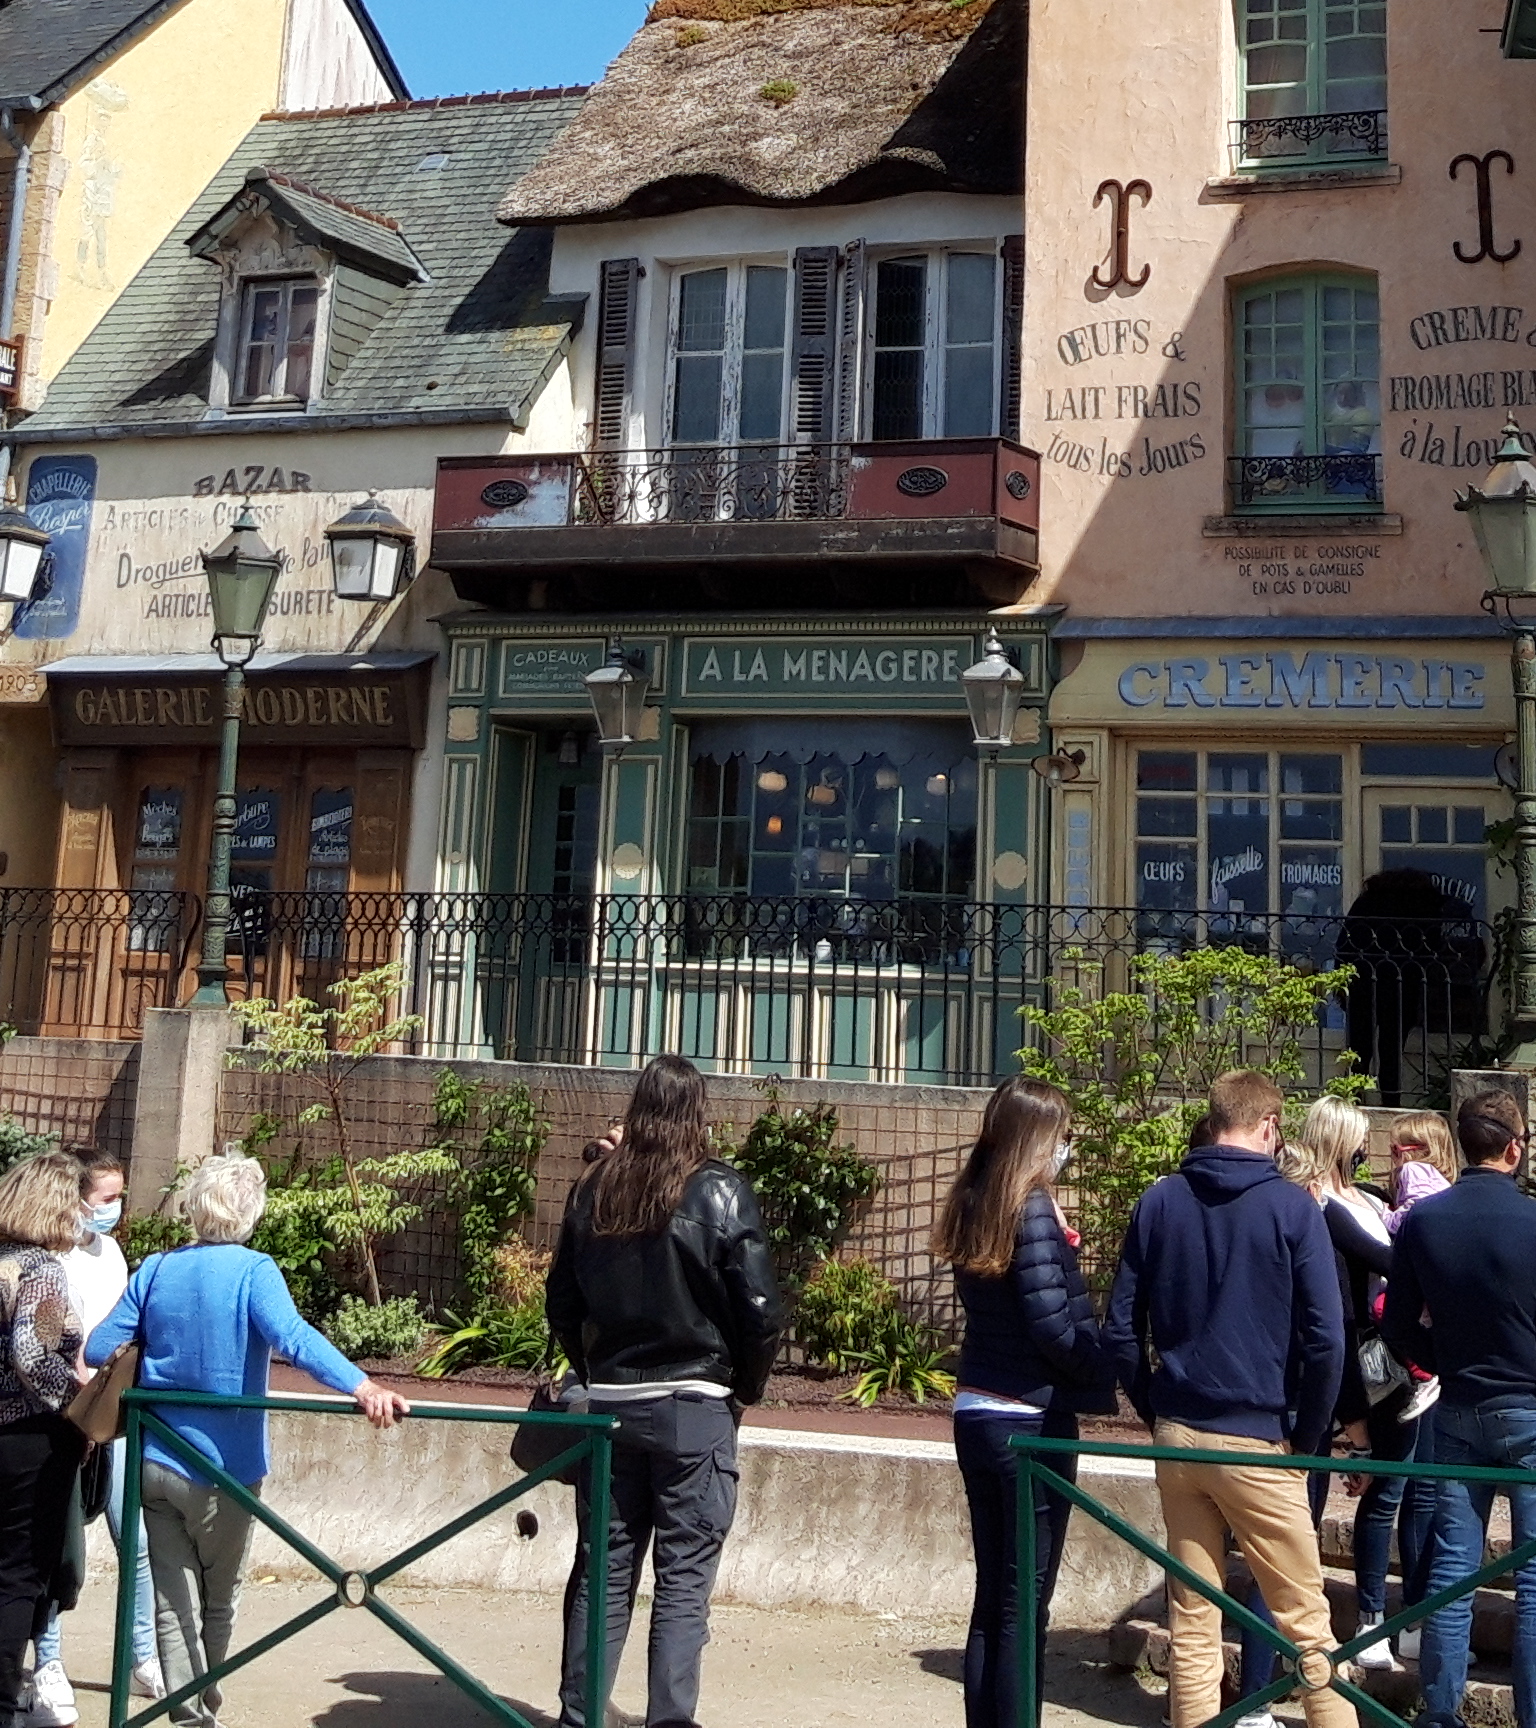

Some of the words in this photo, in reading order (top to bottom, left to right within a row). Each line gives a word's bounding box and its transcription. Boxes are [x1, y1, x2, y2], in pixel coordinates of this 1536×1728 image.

[1057, 319, 1151, 367] ŒUFS
[1162, 331, 1186, 362] &
[1409, 305, 1523, 351] CREME
[1044, 386, 1106, 422] LAIT
[1114, 381, 1201, 419] FRAIS
[1390, 371, 1496, 412] FROMAGE
[1046, 429, 1095, 473] tous
[1097, 435, 1132, 478] les
[1418, 422, 1445, 466] la
[29, 472, 91, 503] CHAPELLERIE
[193, 465, 313, 497] BAZAR
[1238, 564, 1252, 577] DE
[1261, 563, 1289, 576] POTS
[1295, 566, 1305, 577] &
[1309, 562, 1365, 577] GAMELLES
[1294, 546, 1309, 559] DE
[1317, 544, 1381, 559] CONSIGNE
[1252, 581, 1268, 596] EN
[1273, 580, 1296, 595] CAS
[1303, 580, 1351, 595] D'OUBLI
[513, 649, 590, 667] CADEAUX
[699, 646, 723, 682] A
[732, 647, 766, 682] LA
[783, 648, 959, 683] MENAGERE
[1117, 650, 1486, 710] CREMERIE
[74, 687, 214, 727] GALERIE
[1143, 861, 1185, 883] ŒUFS
[1210, 844, 1264, 905] faisselle
[1281, 863, 1342, 886] FROMAGES
